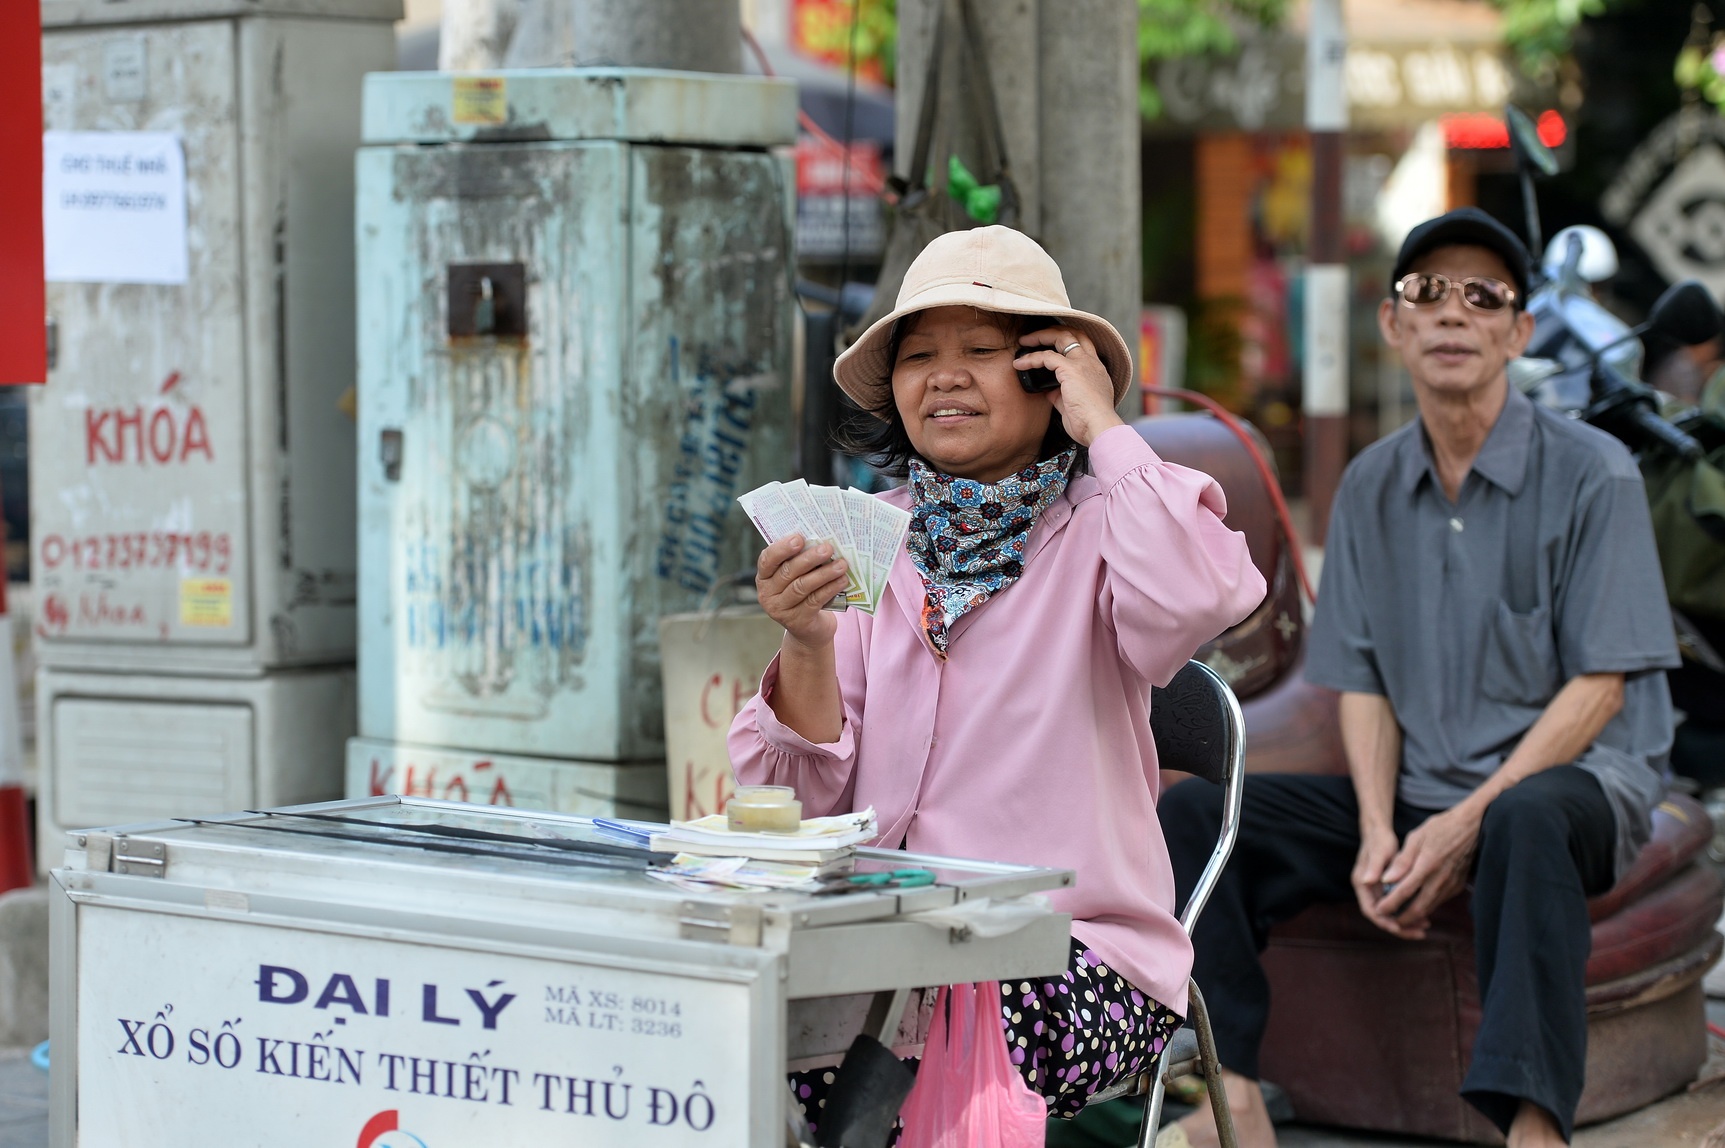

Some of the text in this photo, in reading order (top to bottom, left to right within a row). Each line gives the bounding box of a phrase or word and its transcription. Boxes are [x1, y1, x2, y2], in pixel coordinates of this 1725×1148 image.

[85, 370, 214, 466] KHÓA
[254, 964, 518, 1031] ĐẠI LÝ
[545, 985, 682, 1018] MÃ XS: 8014
[545, 1007, 683, 1039] MÃ LT: 3236
[117, 1003, 716, 1132] XỔ SỐ KIẾN THIẾT THỦ ĐÔ
